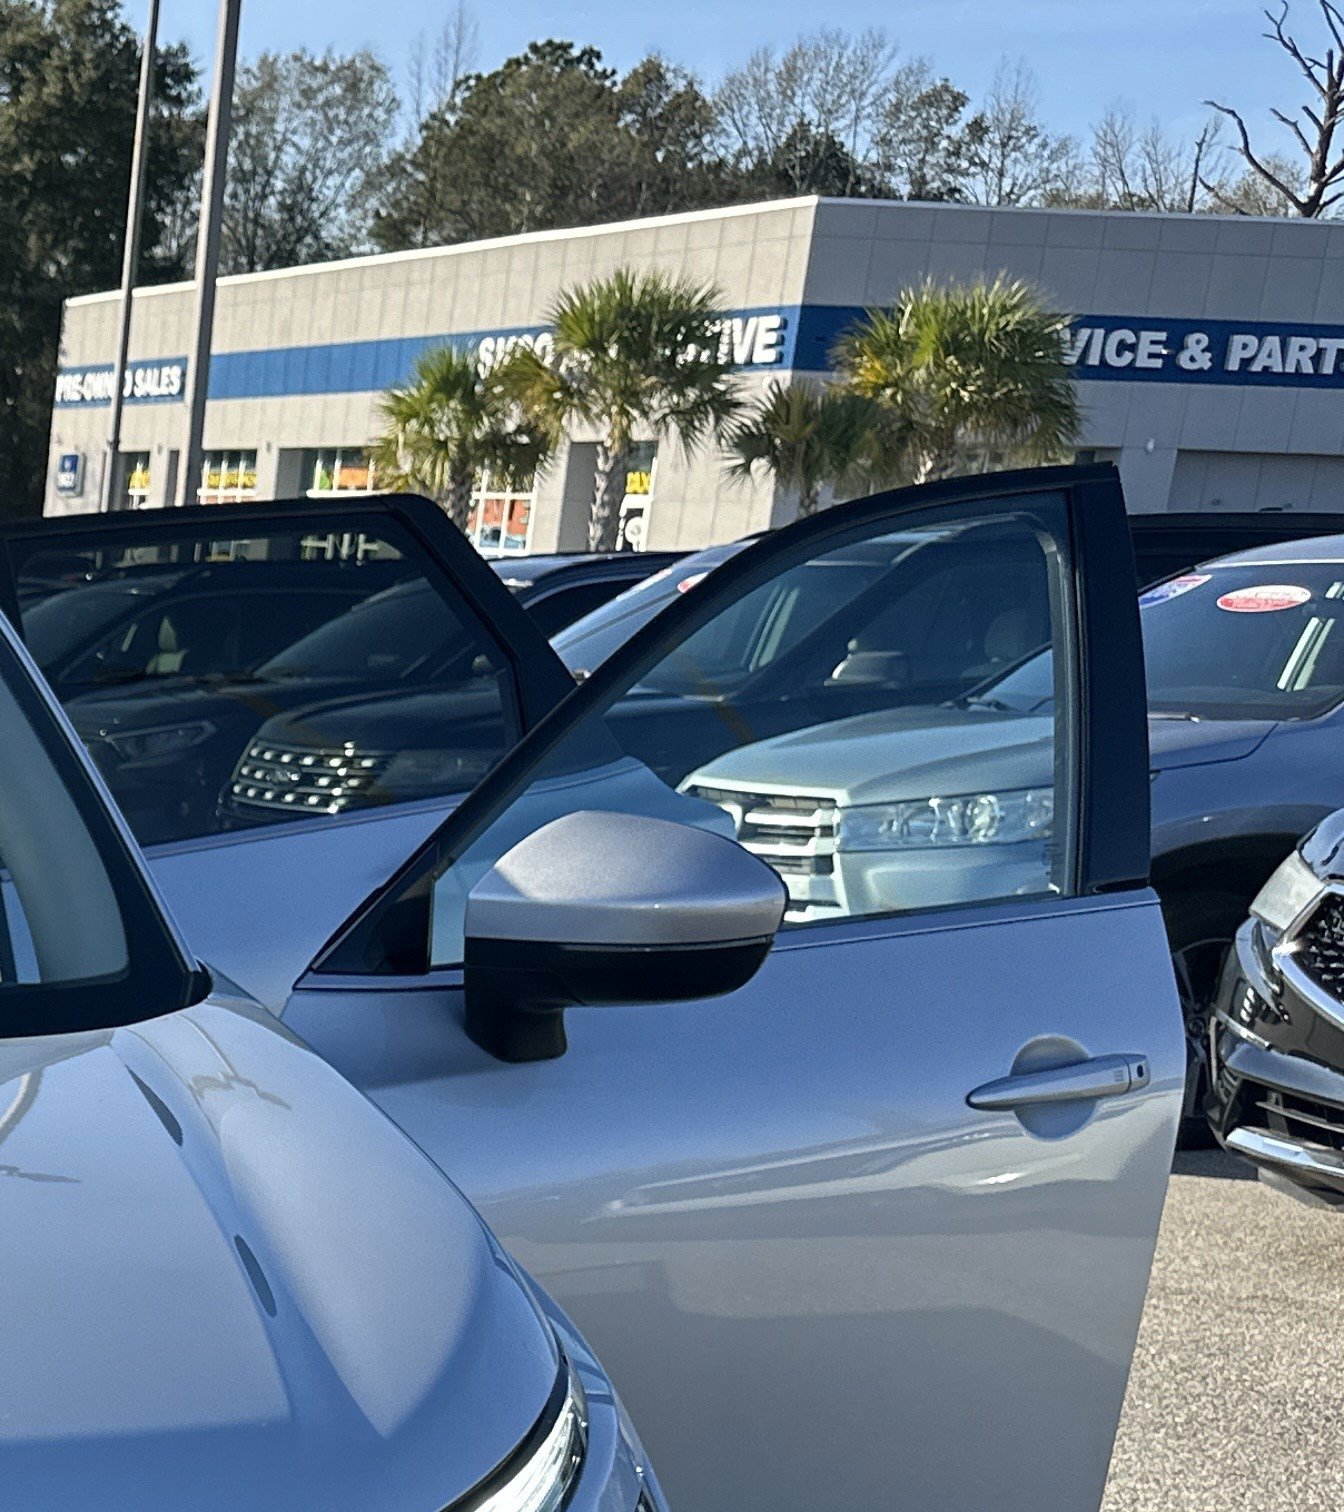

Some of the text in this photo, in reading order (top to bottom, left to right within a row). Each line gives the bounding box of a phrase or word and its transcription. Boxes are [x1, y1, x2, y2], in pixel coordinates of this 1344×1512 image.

[1050, 327, 1344, 375] VICE & PART
[133, 365, 182, 398] SALES
